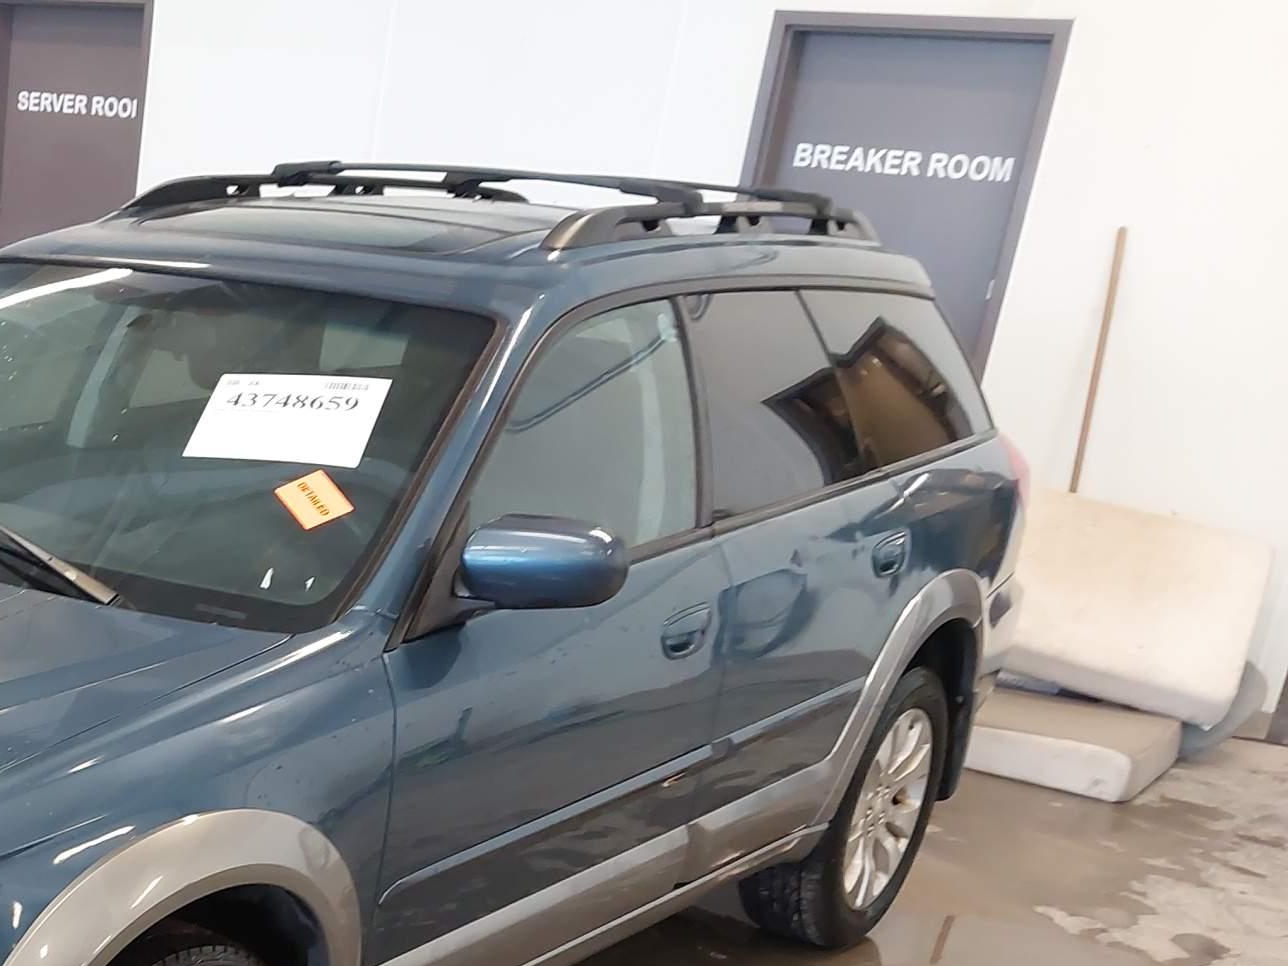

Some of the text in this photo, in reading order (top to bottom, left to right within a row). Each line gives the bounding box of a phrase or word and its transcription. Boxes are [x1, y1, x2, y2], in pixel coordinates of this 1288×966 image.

[17, 90, 137, 119] SERVER ROO
[793, 143, 1016, 183] BREAKER ROOM
[226, 392, 359, 411] 43748659
